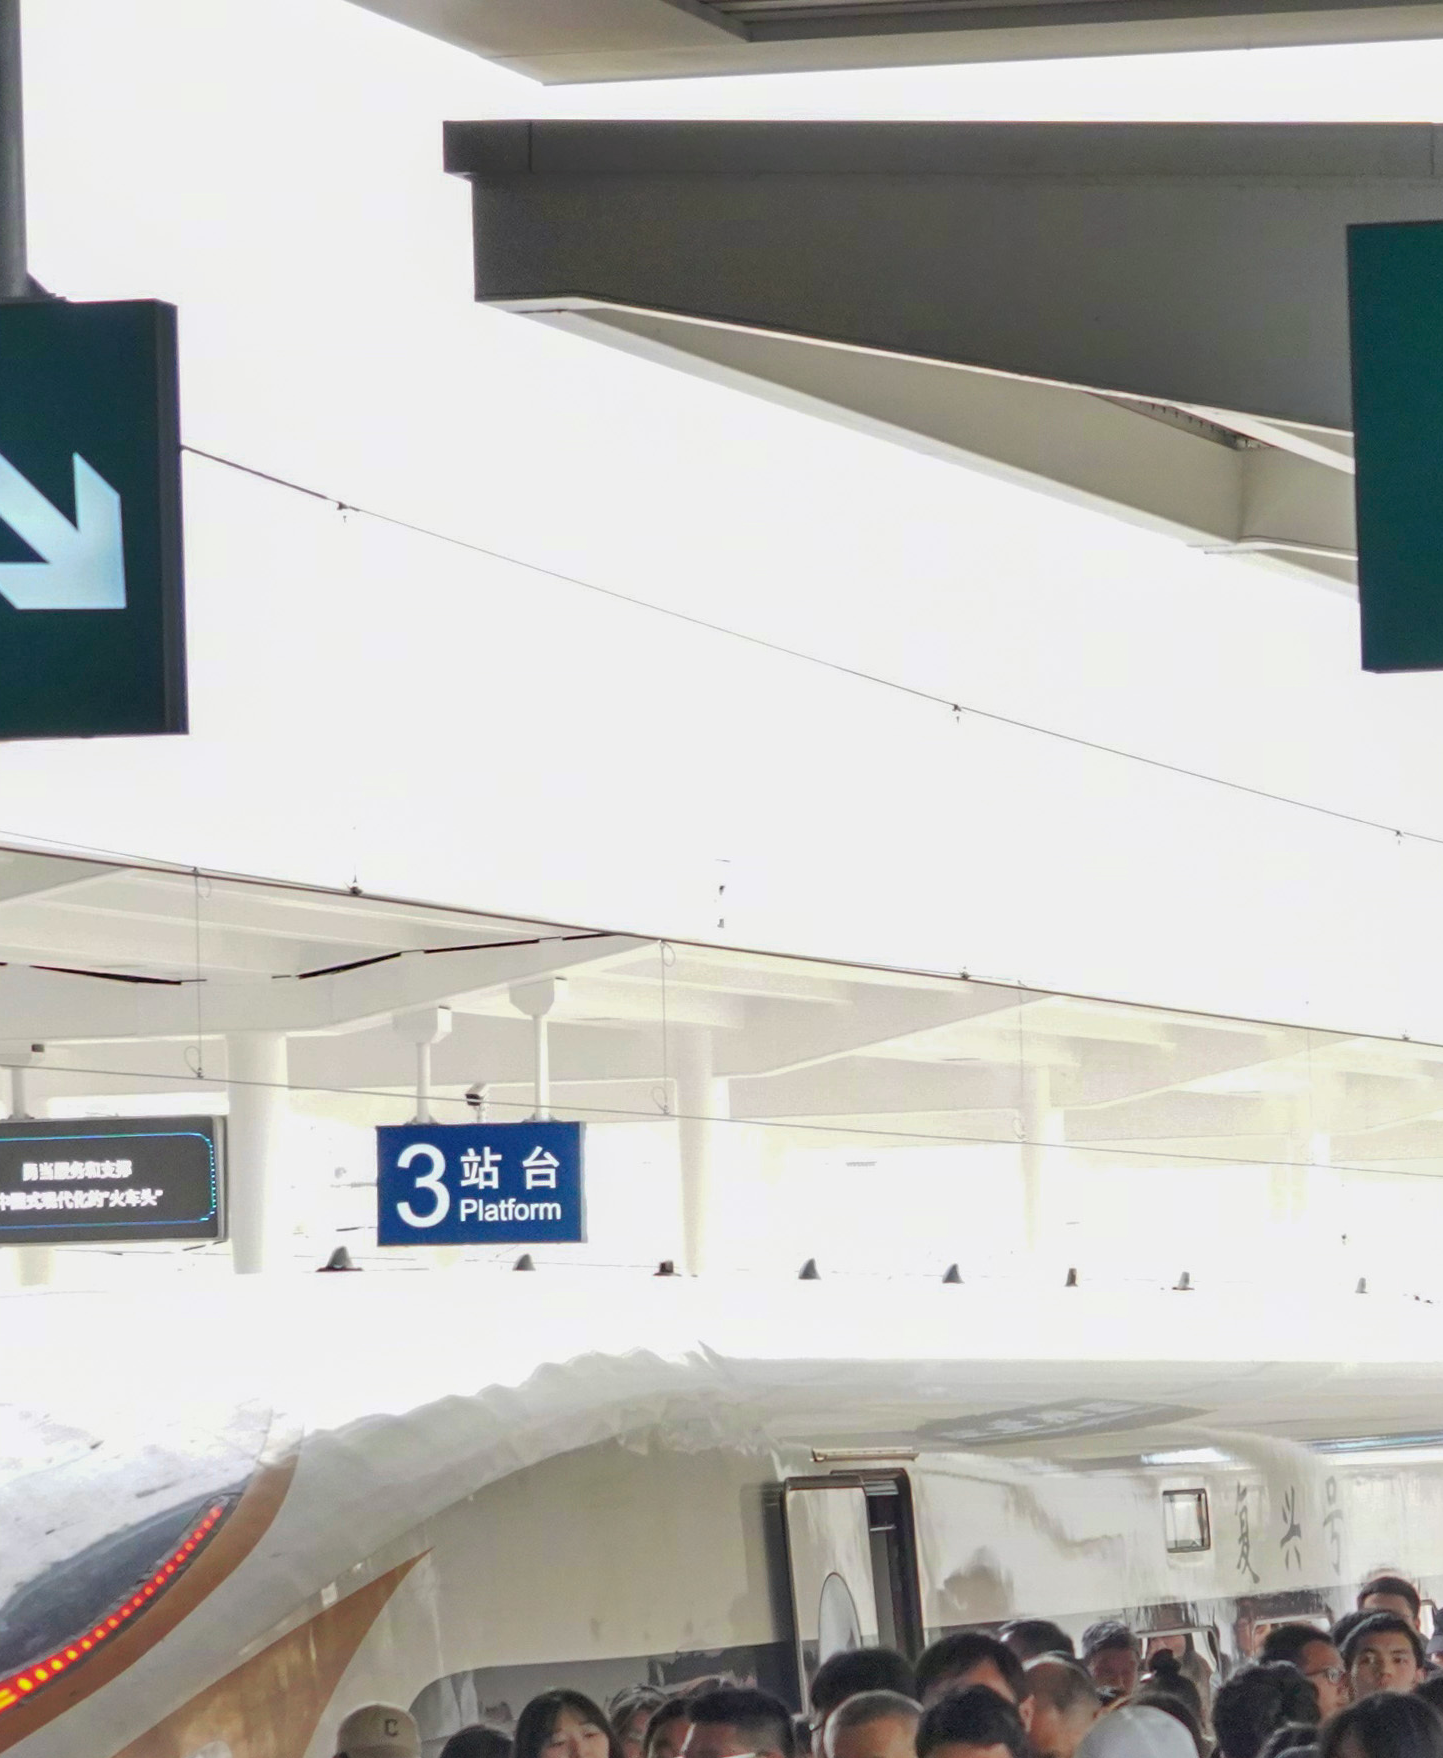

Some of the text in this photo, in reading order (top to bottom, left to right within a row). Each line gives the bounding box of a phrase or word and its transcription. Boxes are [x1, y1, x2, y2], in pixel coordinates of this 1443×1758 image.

[396, 1143, 560, 1228] 3 站台
[459, 1197, 562, 1222] Platform
[1235, 1476, 1344, 1585] 复兴号
